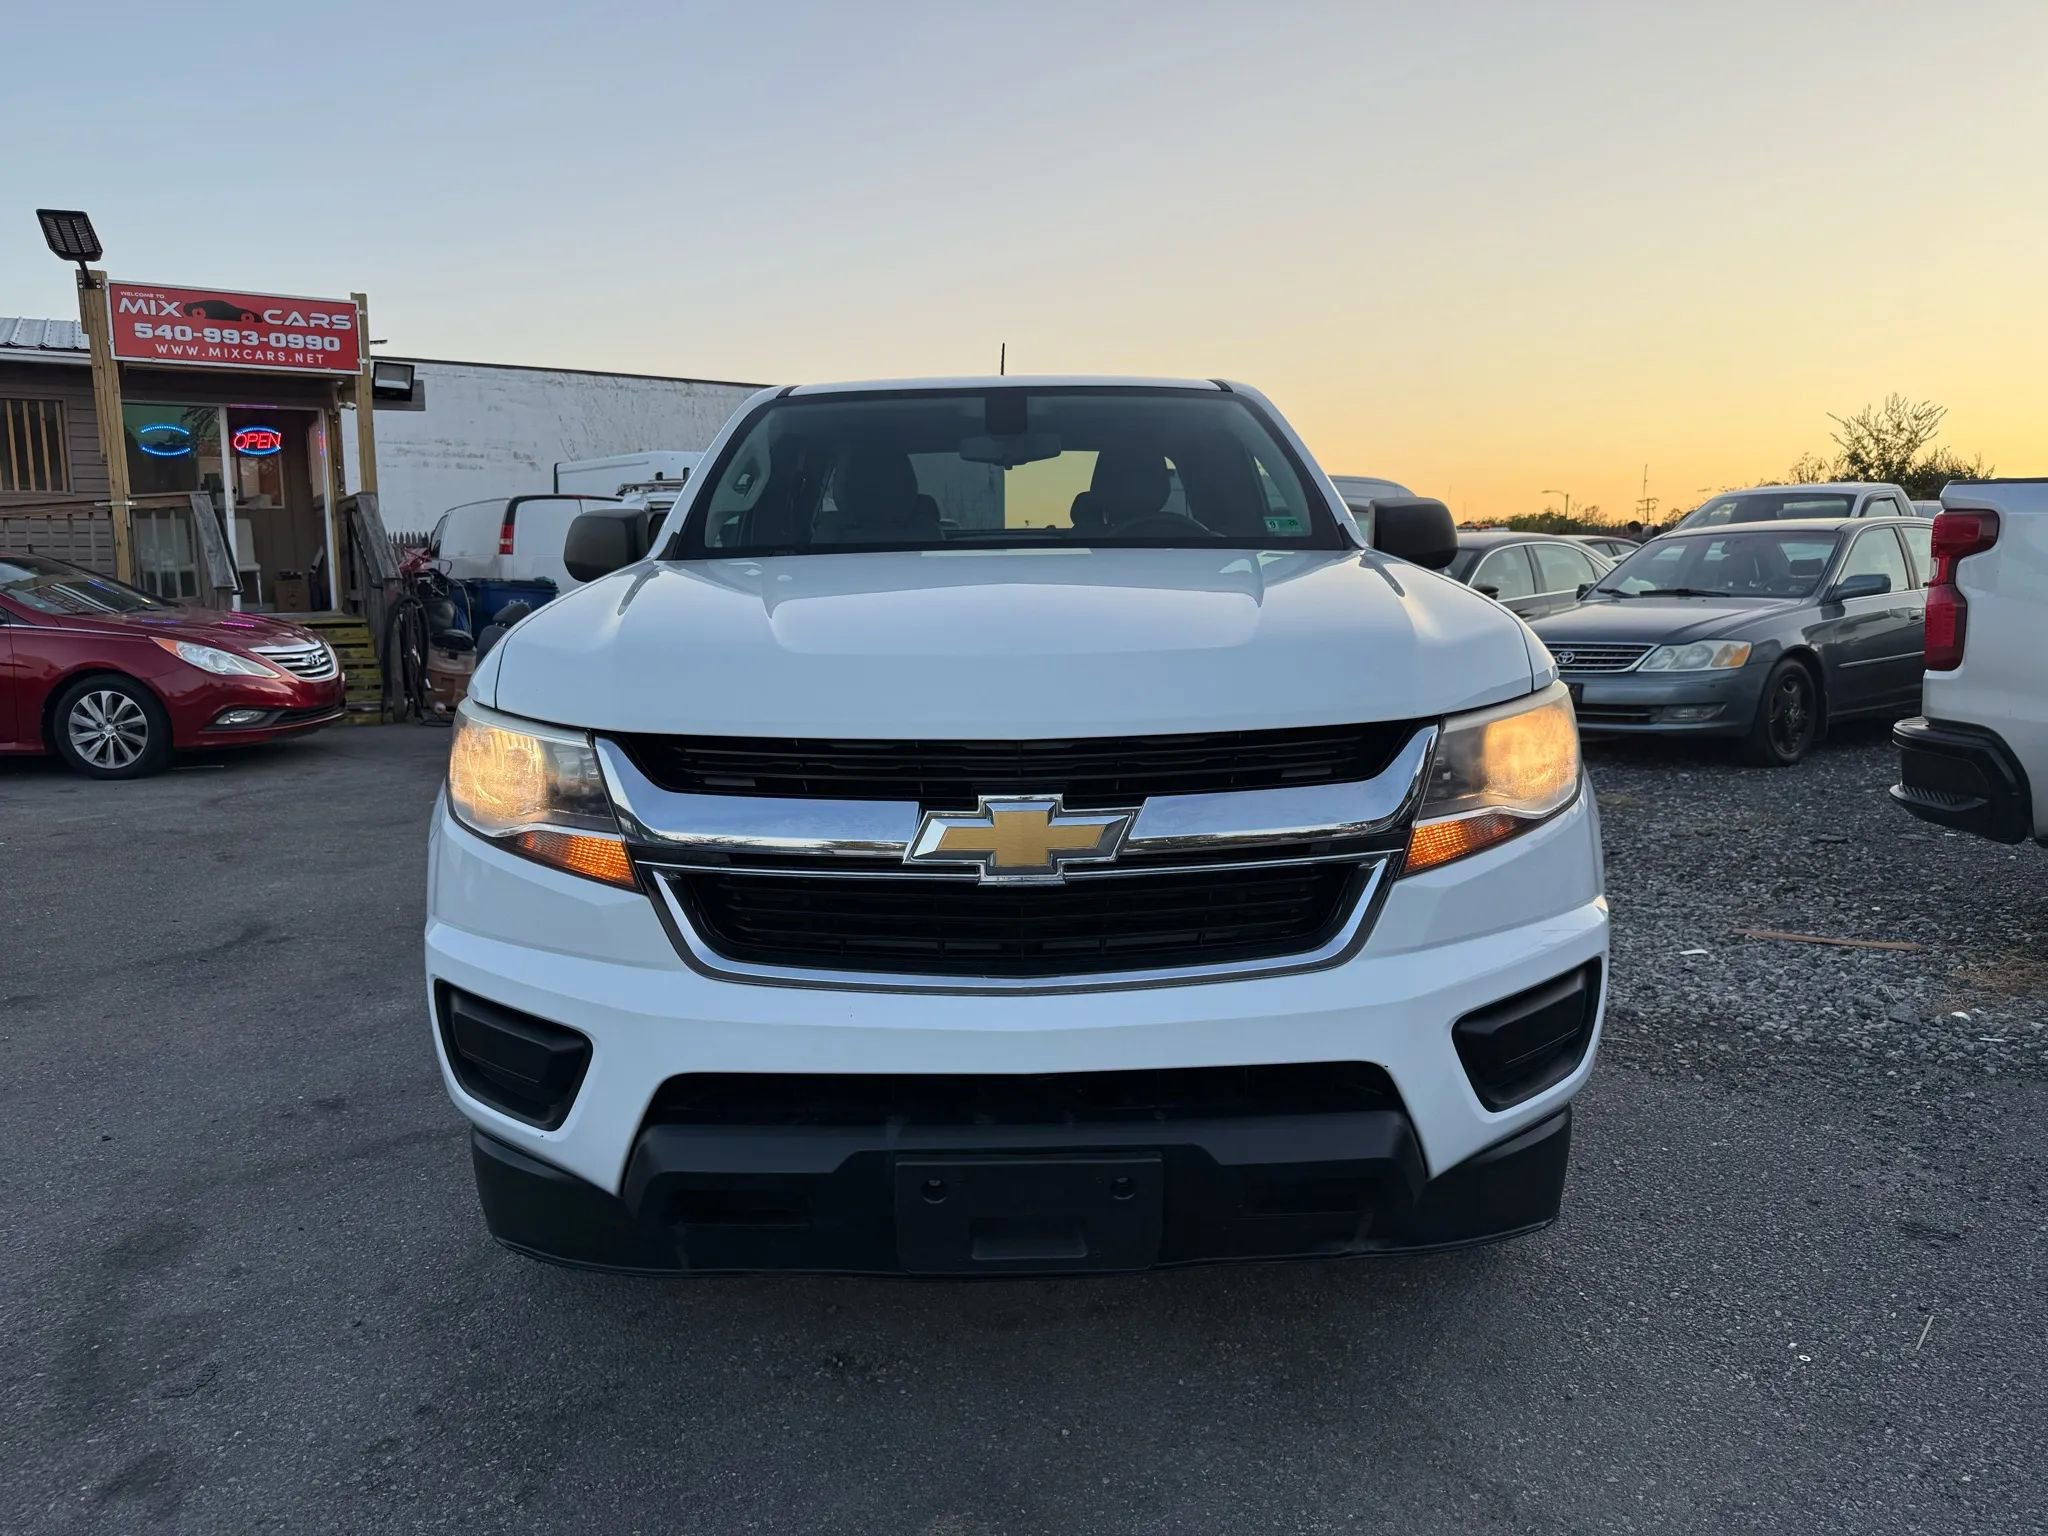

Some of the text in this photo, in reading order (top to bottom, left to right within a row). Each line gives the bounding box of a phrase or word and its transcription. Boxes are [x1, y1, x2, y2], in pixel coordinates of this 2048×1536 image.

[120, 291, 154, 299] WELCOME
[118, 297, 352, 330] MIX CARS
[134, 322, 341, 352] 540-993-0990
[155, 343, 325, 364] WWW.MIXCARS.NET
[233, 432, 282, 449] OPEN
